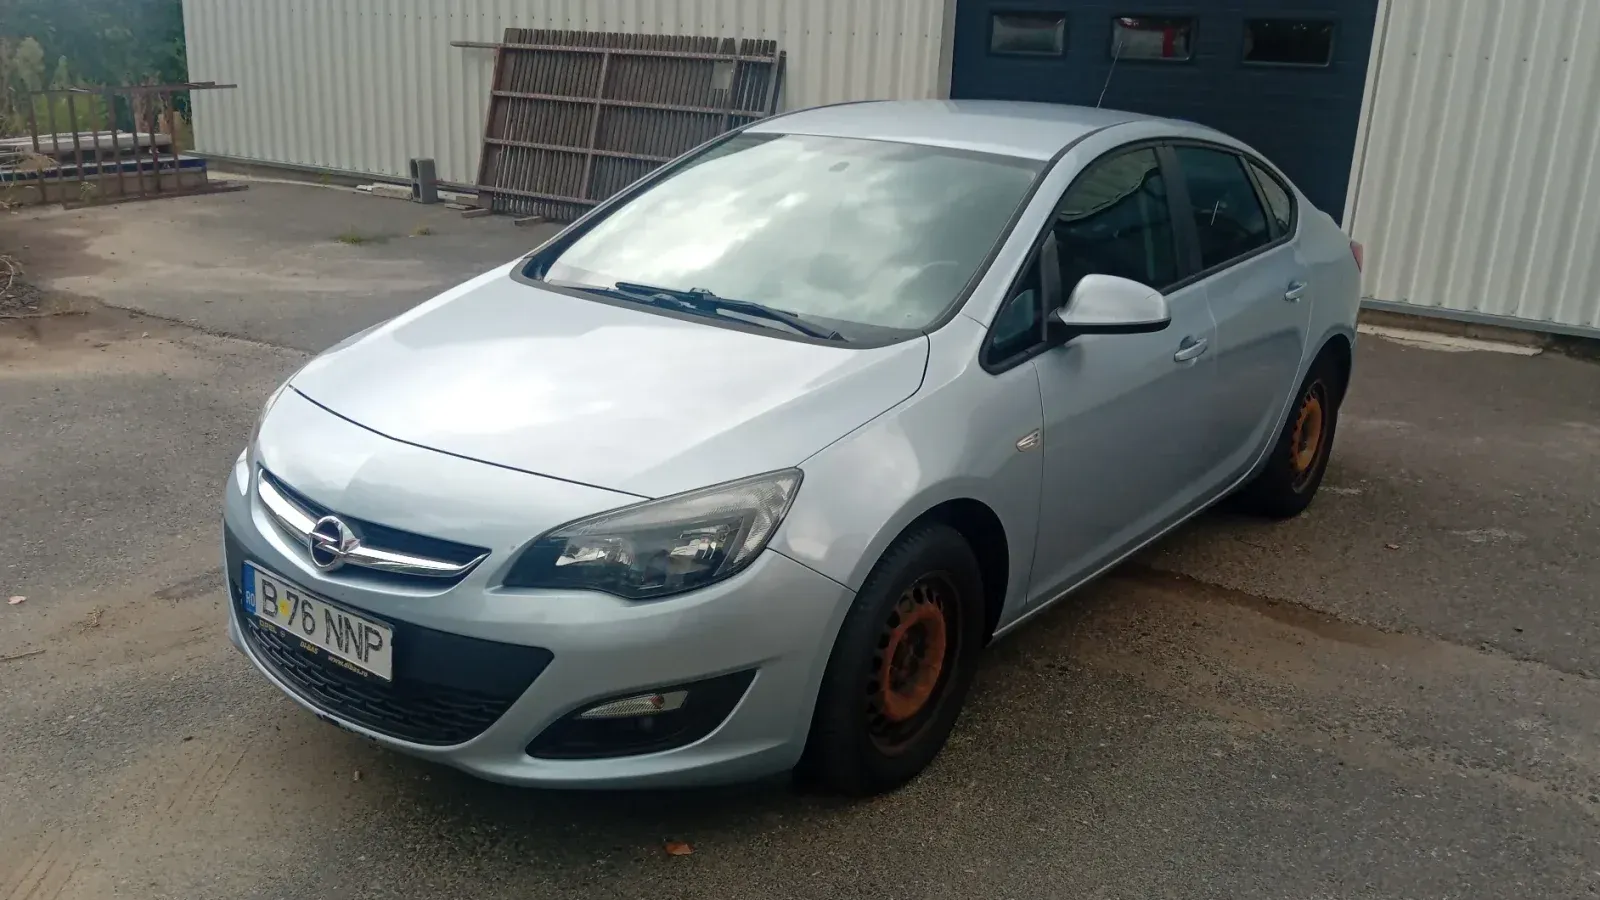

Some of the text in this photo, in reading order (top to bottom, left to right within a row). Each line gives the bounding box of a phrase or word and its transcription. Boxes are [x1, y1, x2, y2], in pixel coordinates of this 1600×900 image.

[245, 590, 256, 607] RO
[262, 579, 383, 663] B 76 NNP
